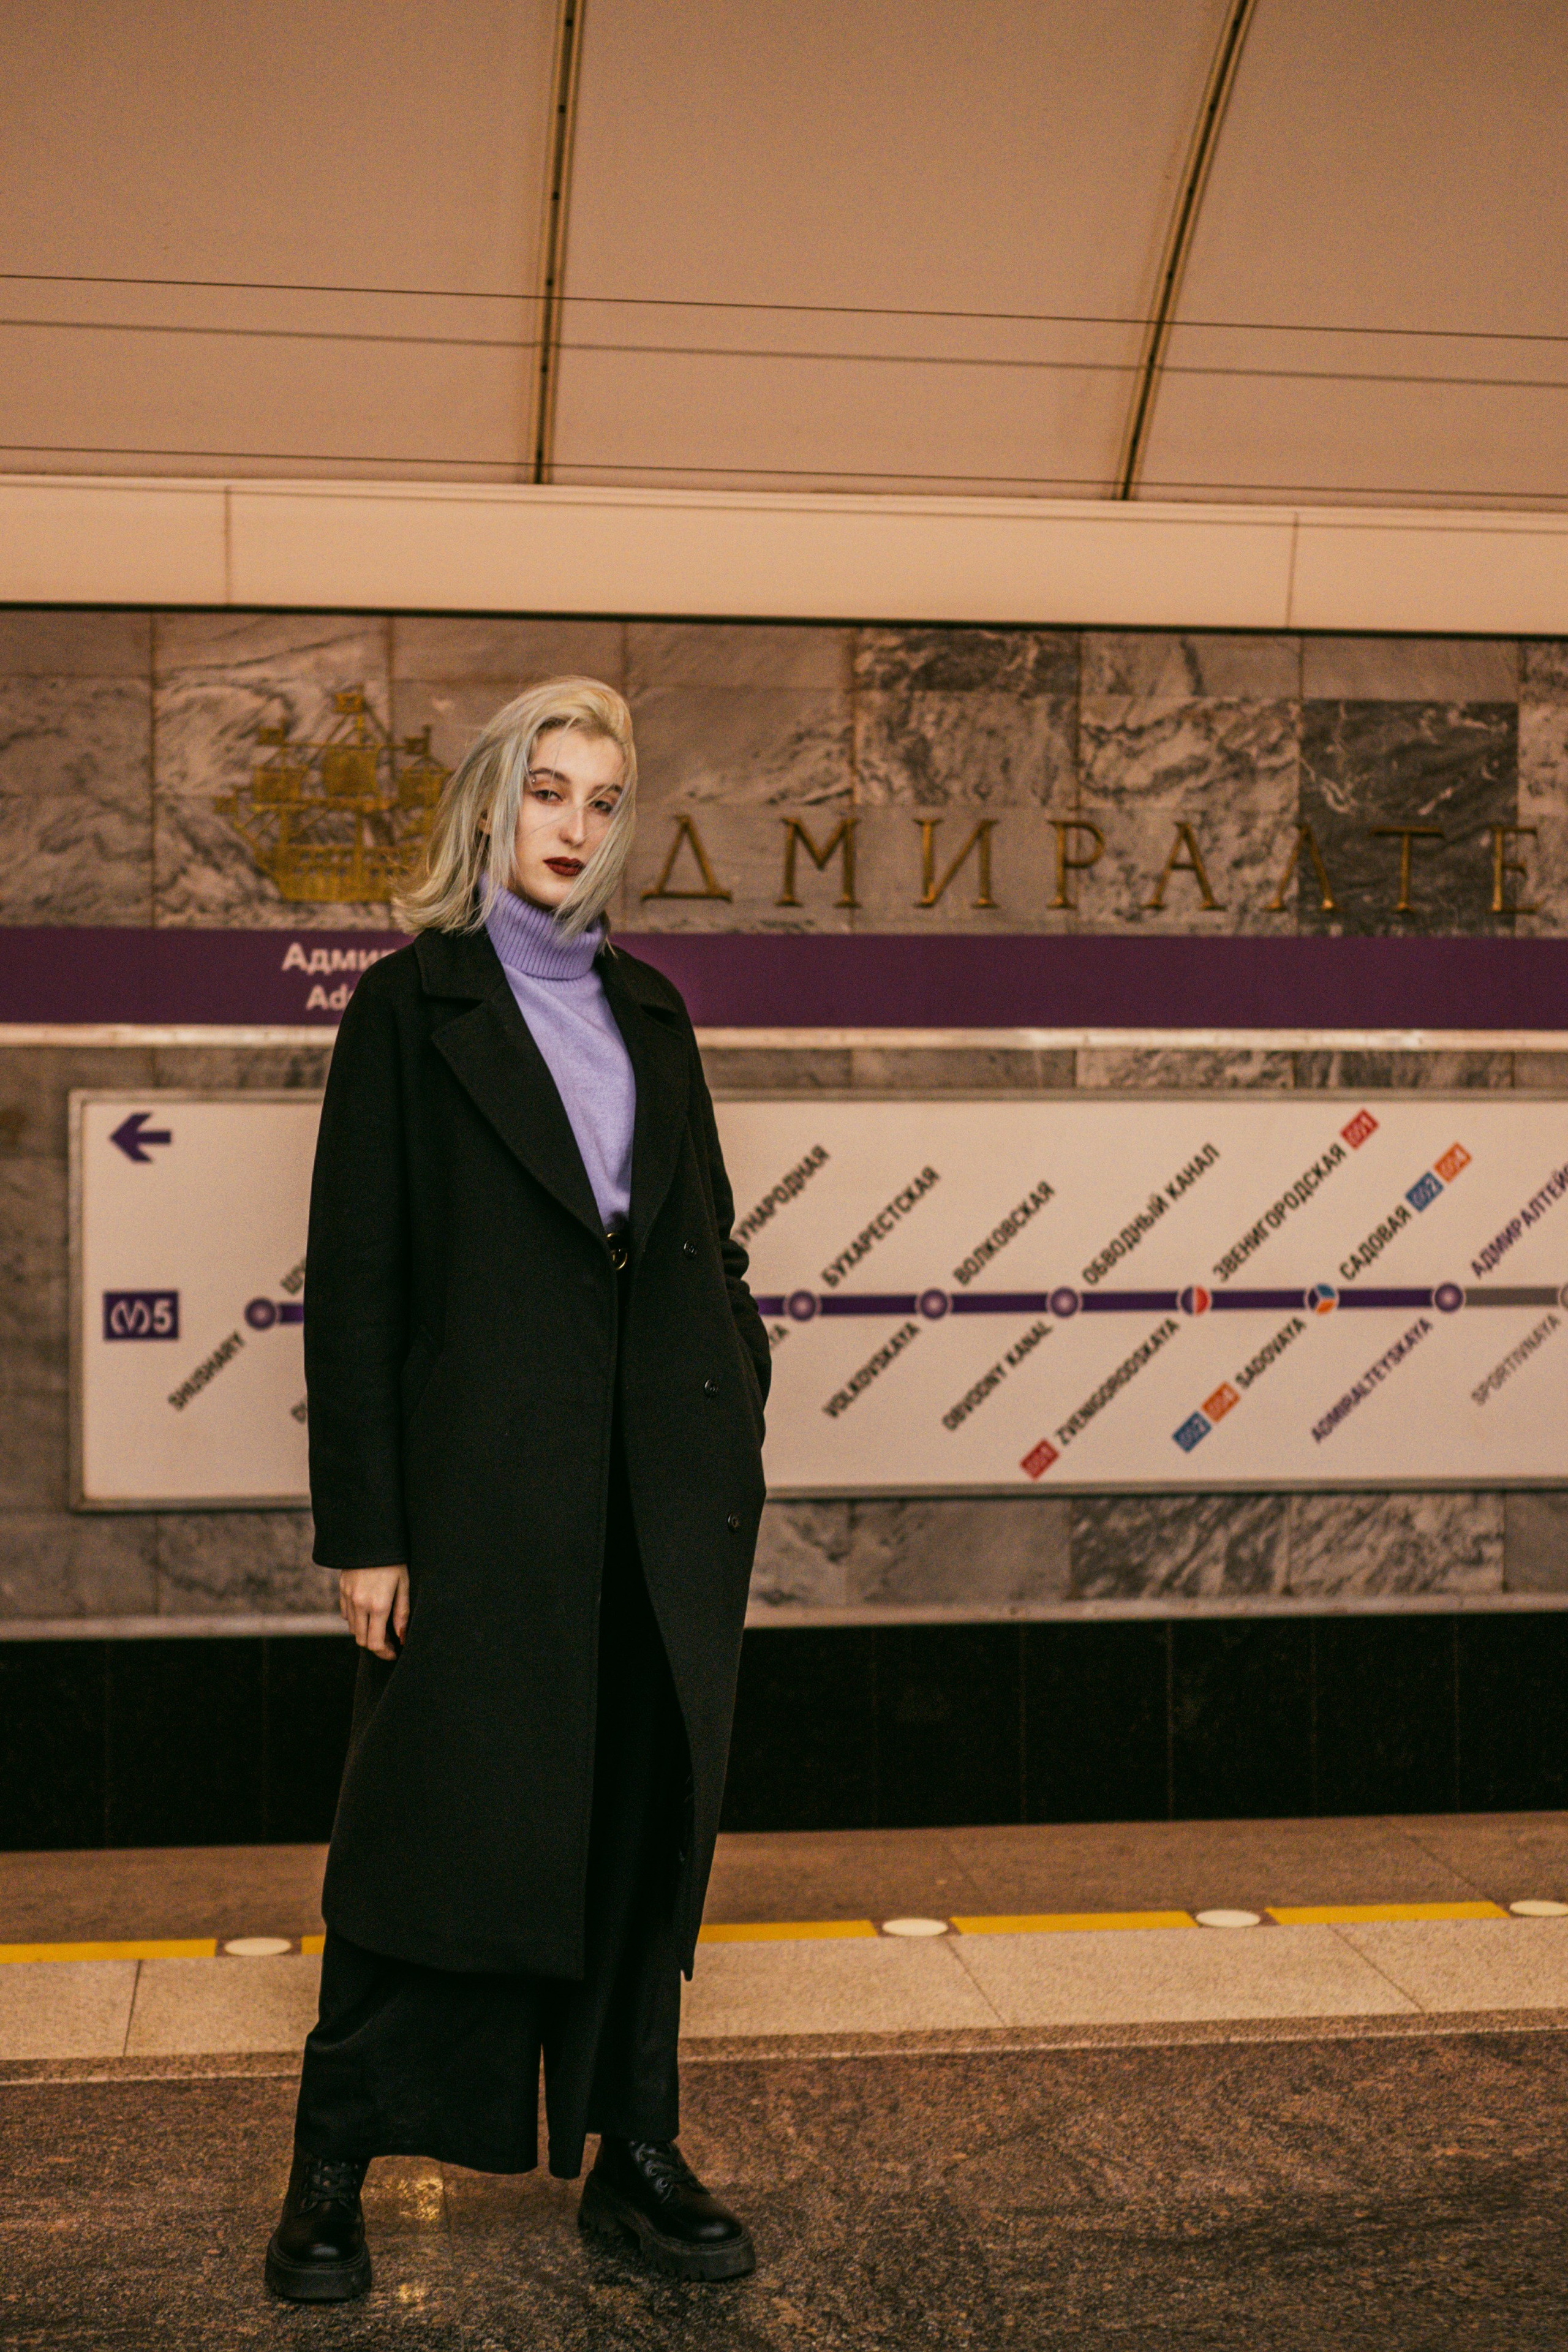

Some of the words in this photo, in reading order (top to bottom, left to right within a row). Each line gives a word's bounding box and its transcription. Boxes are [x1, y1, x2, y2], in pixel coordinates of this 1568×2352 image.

[281, 941, 397, 976] Адми
[733, 1144, 829, 1248] УНАРОДНАЯ
[821, 1166, 940, 1289] БУХАРЕСТСКАЯ
[952, 1180, 1055, 1286] ВОЛКОВСКАЯ
[1082, 1193, 1169, 1286] ОБВОДНЫЙ
[1164, 1142, 1221, 1201] КАНАЛ
[1212, 1143, 1346, 1283] ЗВЕНИГОРОДСКАЯ
[1340, 1204, 1411, 1281] САДОВАЯ
[823, 1321, 921, 1419] VOLKOVSKAYA
[1005, 1321, 1053, 1368] KANAL
[1055, 1317, 1180, 1445] ZVENIGORODSKAYA
[1234, 1316, 1306, 1390] SADOVAYA
[1310, 1317, 1433, 1444] ADMIRALTEYSKAYA
